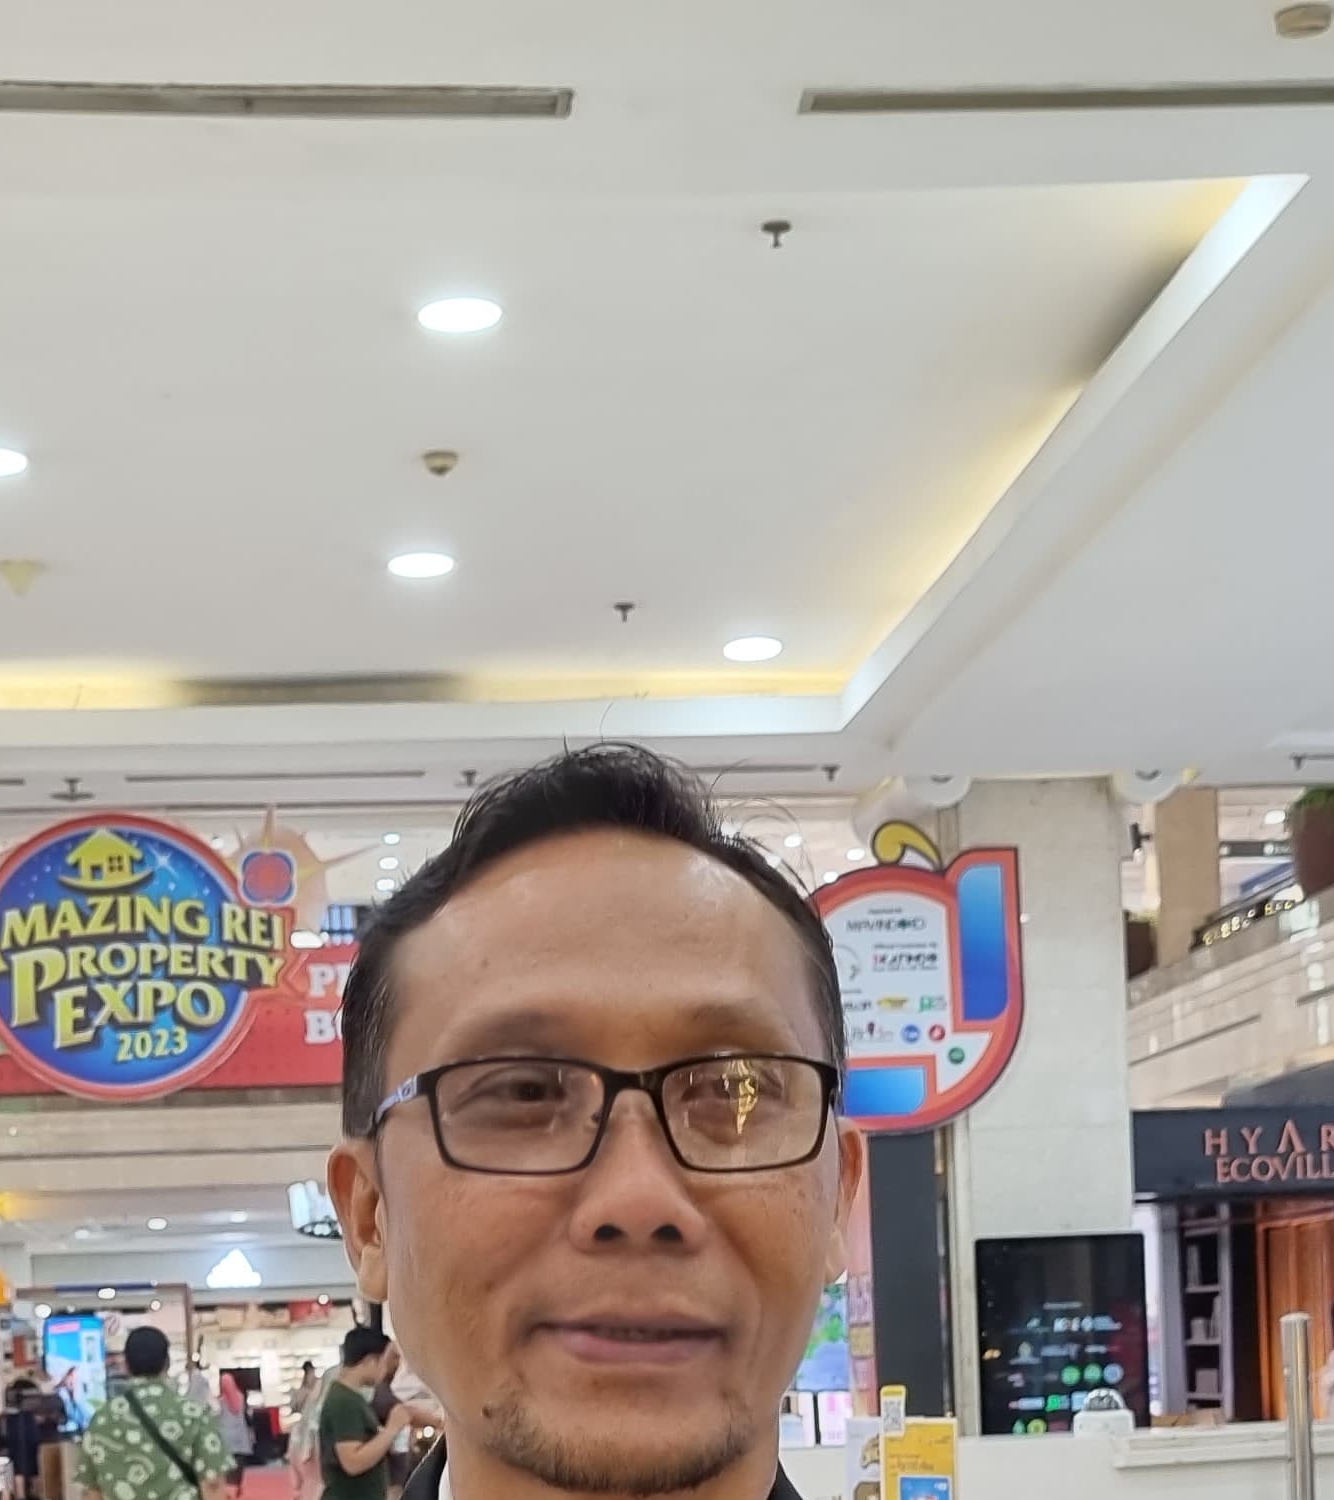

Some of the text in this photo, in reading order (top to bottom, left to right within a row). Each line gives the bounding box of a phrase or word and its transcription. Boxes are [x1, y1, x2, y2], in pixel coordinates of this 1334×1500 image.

[222, 902, 284, 950] REI
[10, 941, 285, 1028] PROPERTY
[53, 980, 226, 1049] EXPO
[116, 1026, 188, 1062] 2023
